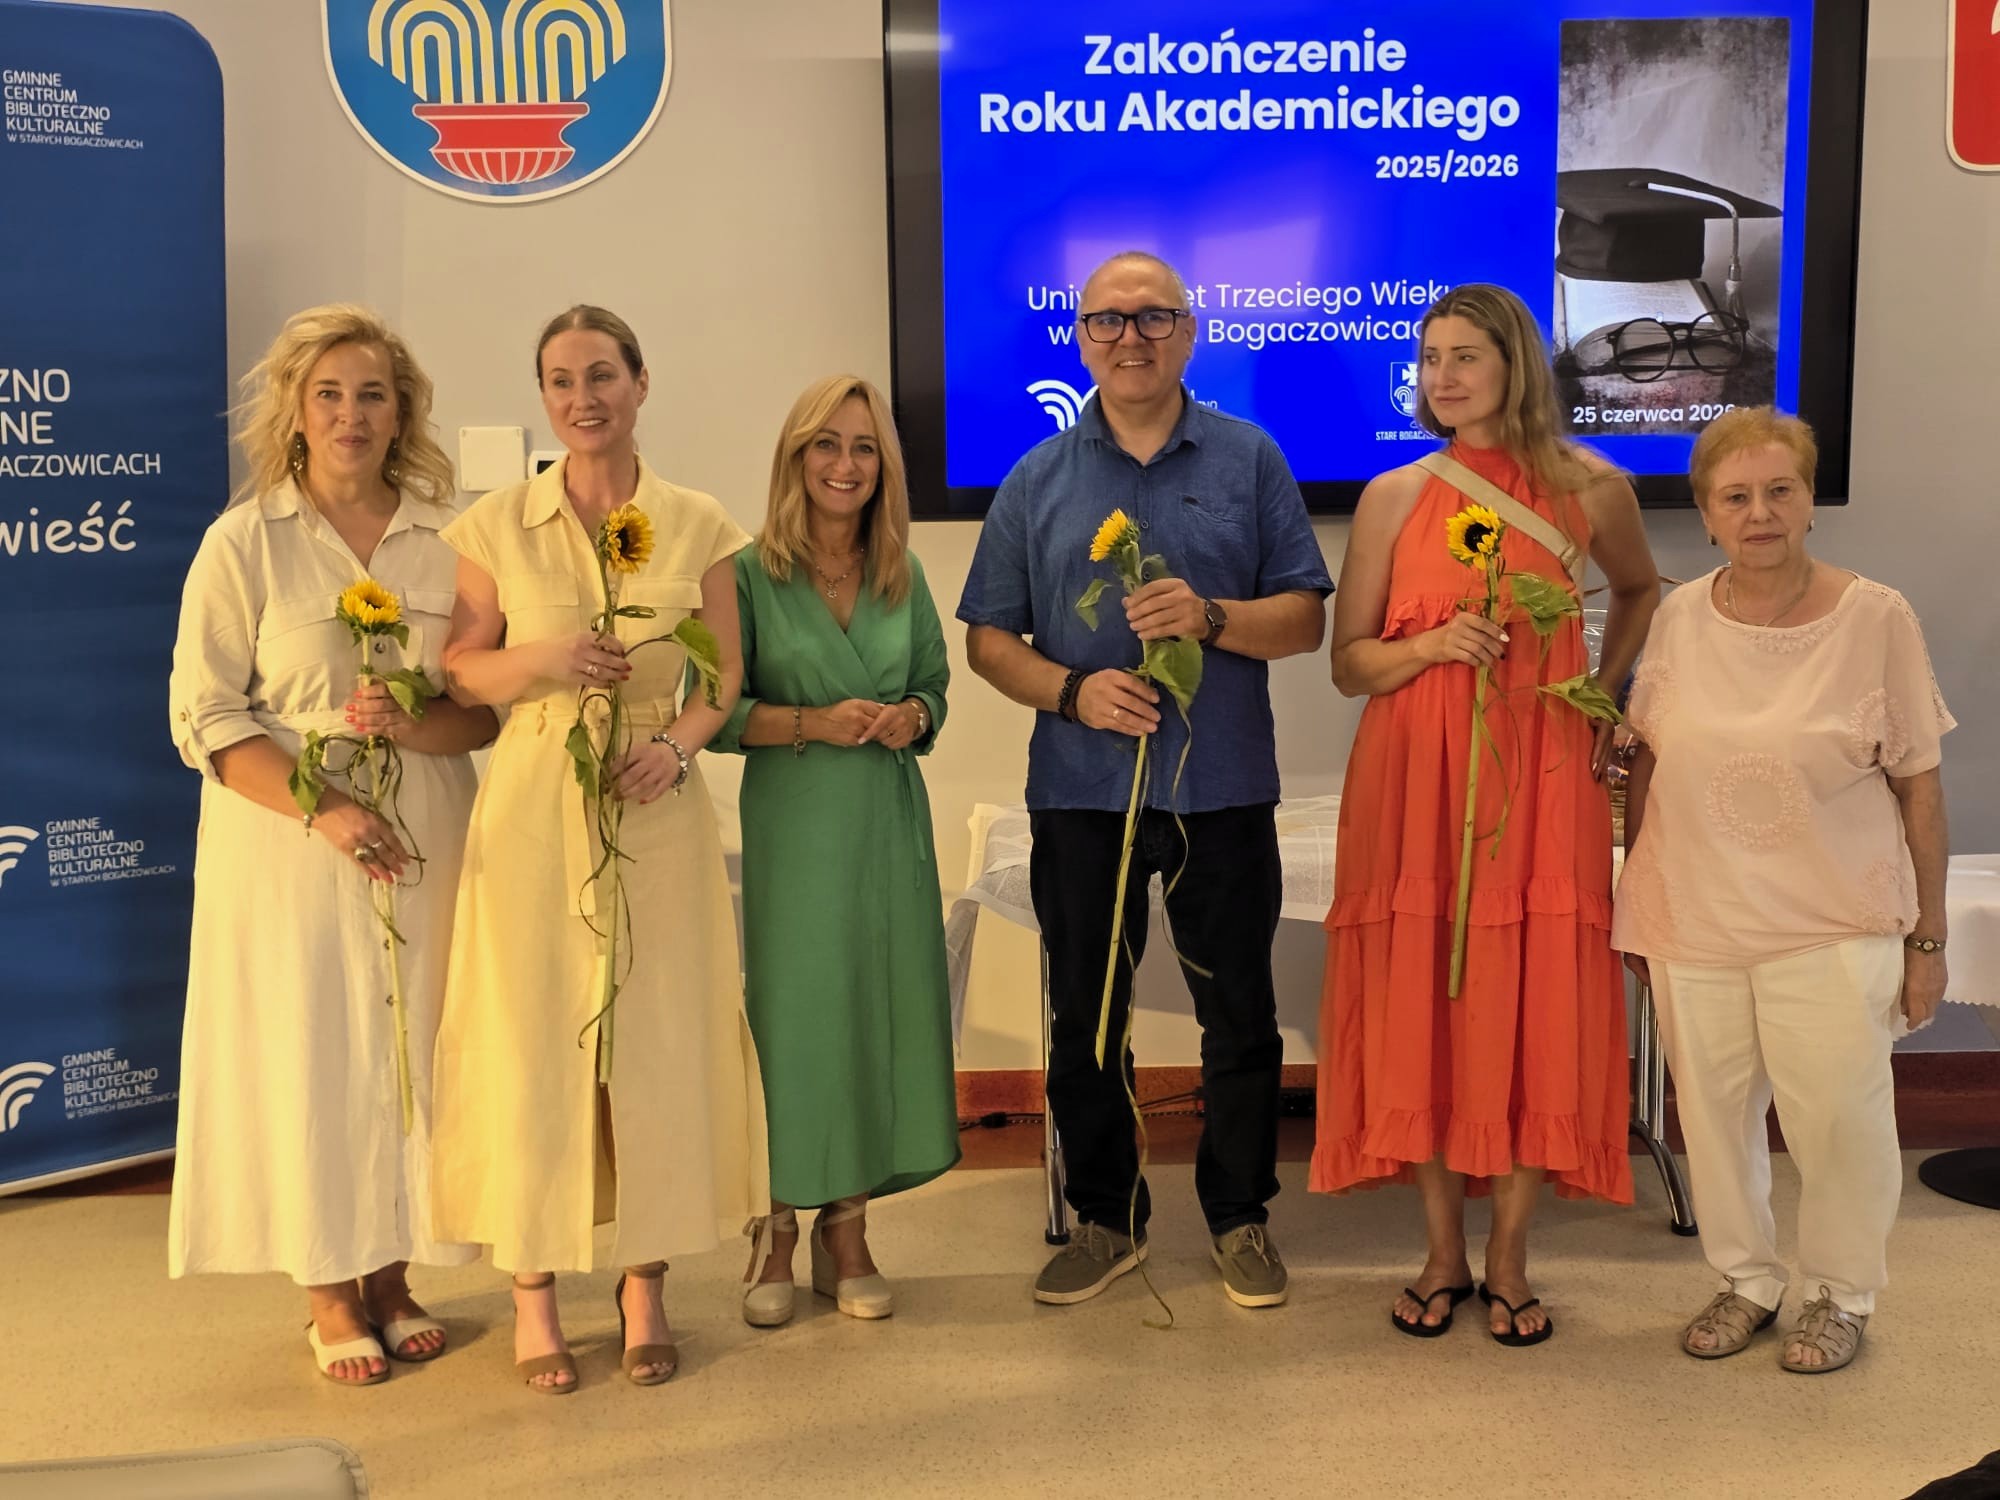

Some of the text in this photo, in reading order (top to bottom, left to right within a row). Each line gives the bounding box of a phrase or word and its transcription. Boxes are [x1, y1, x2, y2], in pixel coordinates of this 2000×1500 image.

[1084, 28, 1407, 75] Zakończenie
[3, 70, 62, 87] GMINNE
[4, 86, 78, 103] CENTRUM
[5, 101, 111, 121] BIBLIOTECZNO
[979, 84, 1521, 142] Roku Akademickiego
[6, 117, 104, 136] KULTURALNE
[8, 134, 144, 149] W STARYCH BOGACZOWICACH
[1375, 150, 1520, 183] 2025/2026
[1215, 282, 1362, 314] Trzeciego
[1048, 325, 1073, 345] w
[1573, 406, 1597, 424] 25
[1601, 407, 1684, 423] czerwca
[1375, 431, 1398, 441] STARE
[46, 817, 101, 834] GMINNE
[47, 829, 115, 849] CENTRUM
[48, 840, 144, 863] BIBLIOTECZNO
[49, 854, 139, 876] KULTURALNE
[62, 872, 101, 887] STARYCH
[102, 864, 176, 881] BOGACZOWICACH
[62, 1048, 115, 1068] GMINNE
[63, 1059, 129, 1082] CENTRUM
[63, 1068, 159, 1096] BIBLIOTECZNO
[65, 1082, 153, 1109] KULTURALNE
